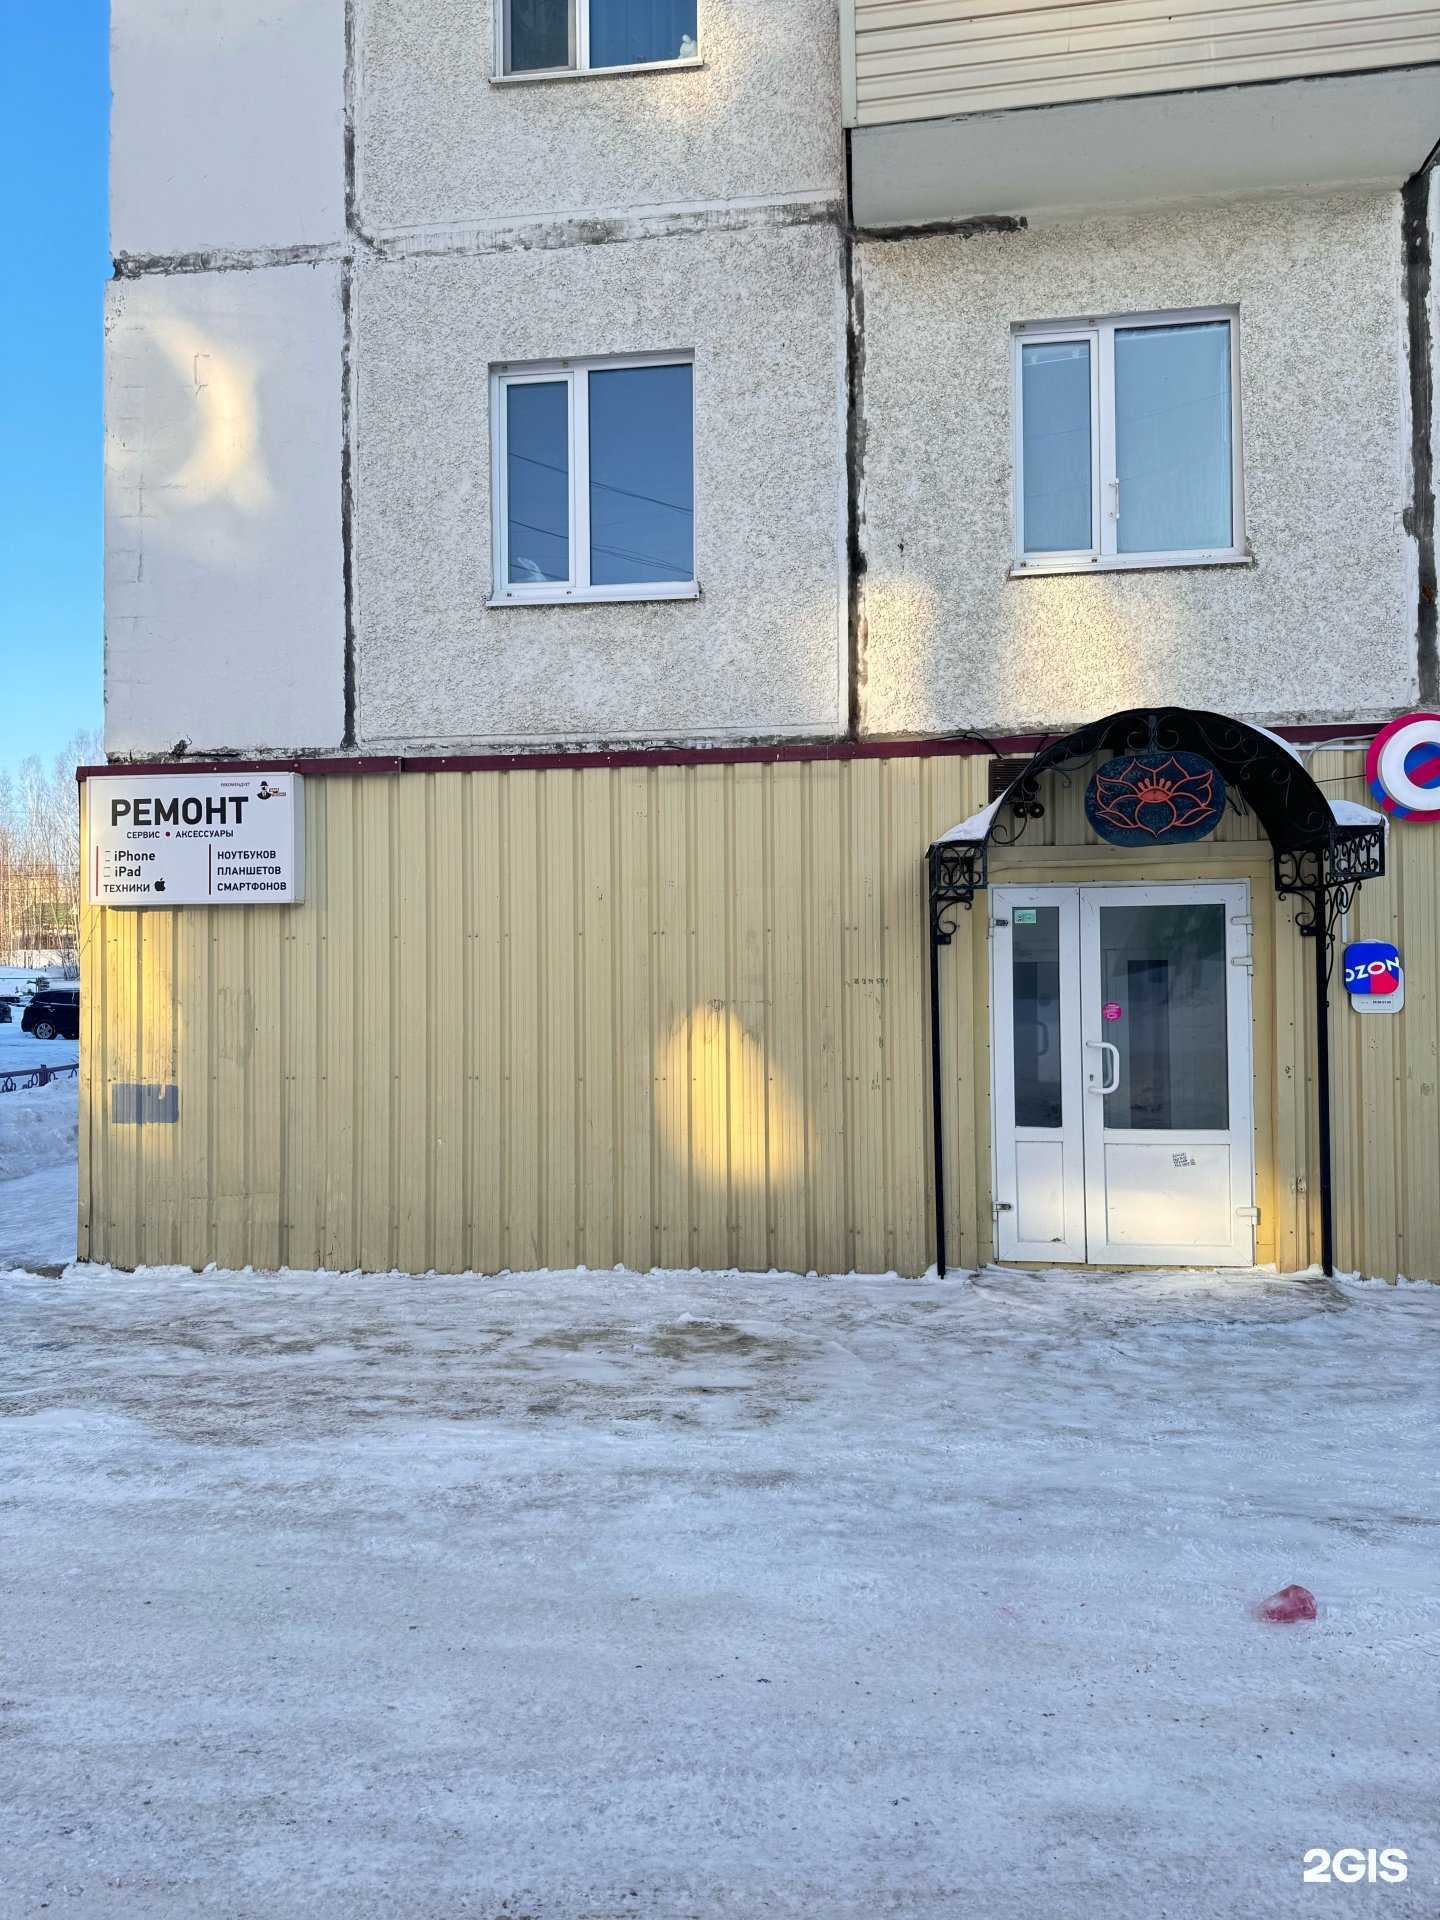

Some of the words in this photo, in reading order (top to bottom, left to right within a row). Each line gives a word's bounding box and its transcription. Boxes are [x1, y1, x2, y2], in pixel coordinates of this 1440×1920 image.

[111, 796, 249, 827] РЕМОНТ
[126, 831, 161, 839] СЕРВИС
[175, 829, 234, 838] АКСЕССУАРЫ
[114, 851, 156, 862] iPhone
[217, 850, 277, 860] НОУТБУКОВ
[114, 866, 141, 877] iPad
[217, 866, 281, 875] ПЛАНШЕТОВ
[103, 884, 150, 893] ТЕХНИКИ
[217, 882, 287, 892] СМАРТФОНОВ
[1345, 956, 1400, 982] OZON
